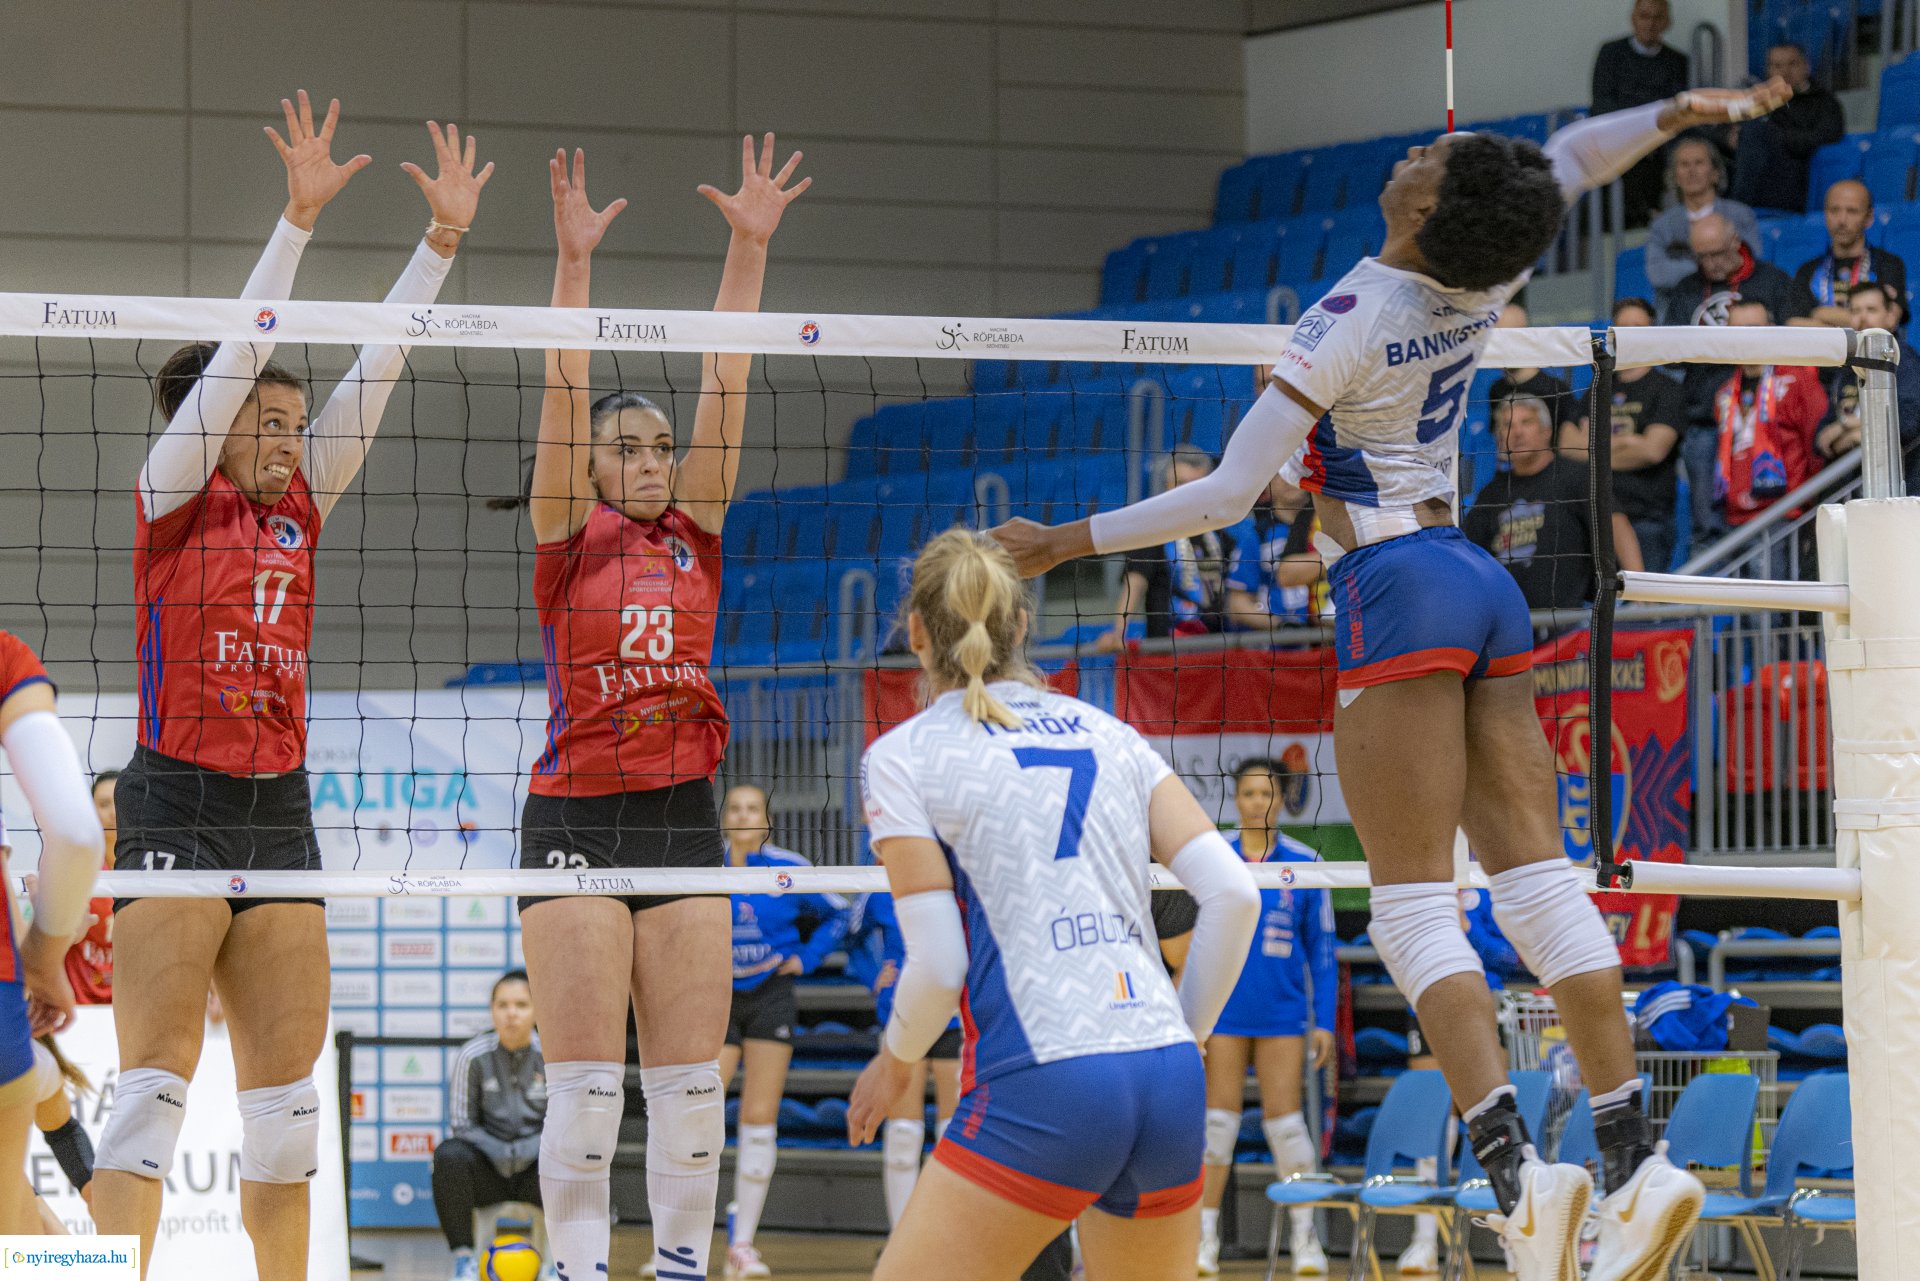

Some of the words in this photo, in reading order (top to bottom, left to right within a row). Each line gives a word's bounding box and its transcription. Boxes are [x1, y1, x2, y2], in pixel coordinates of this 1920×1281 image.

[42, 301, 118, 325] FATUM
[444, 317, 499, 330] RÖPLABDA
[596, 315, 667, 340] FATUM
[973, 331, 1024, 343] RÖPLABDA
[1121, 328, 1190, 351] FATUM
[1416, 352, 1474, 445] 5
[253, 569, 297, 625] 17
[620, 603, 674, 661] 23
[1011, 747, 1098, 861] 7
[575, 872, 634, 890] FATUM
[1051, 906, 1143, 951] ÓBUDA
